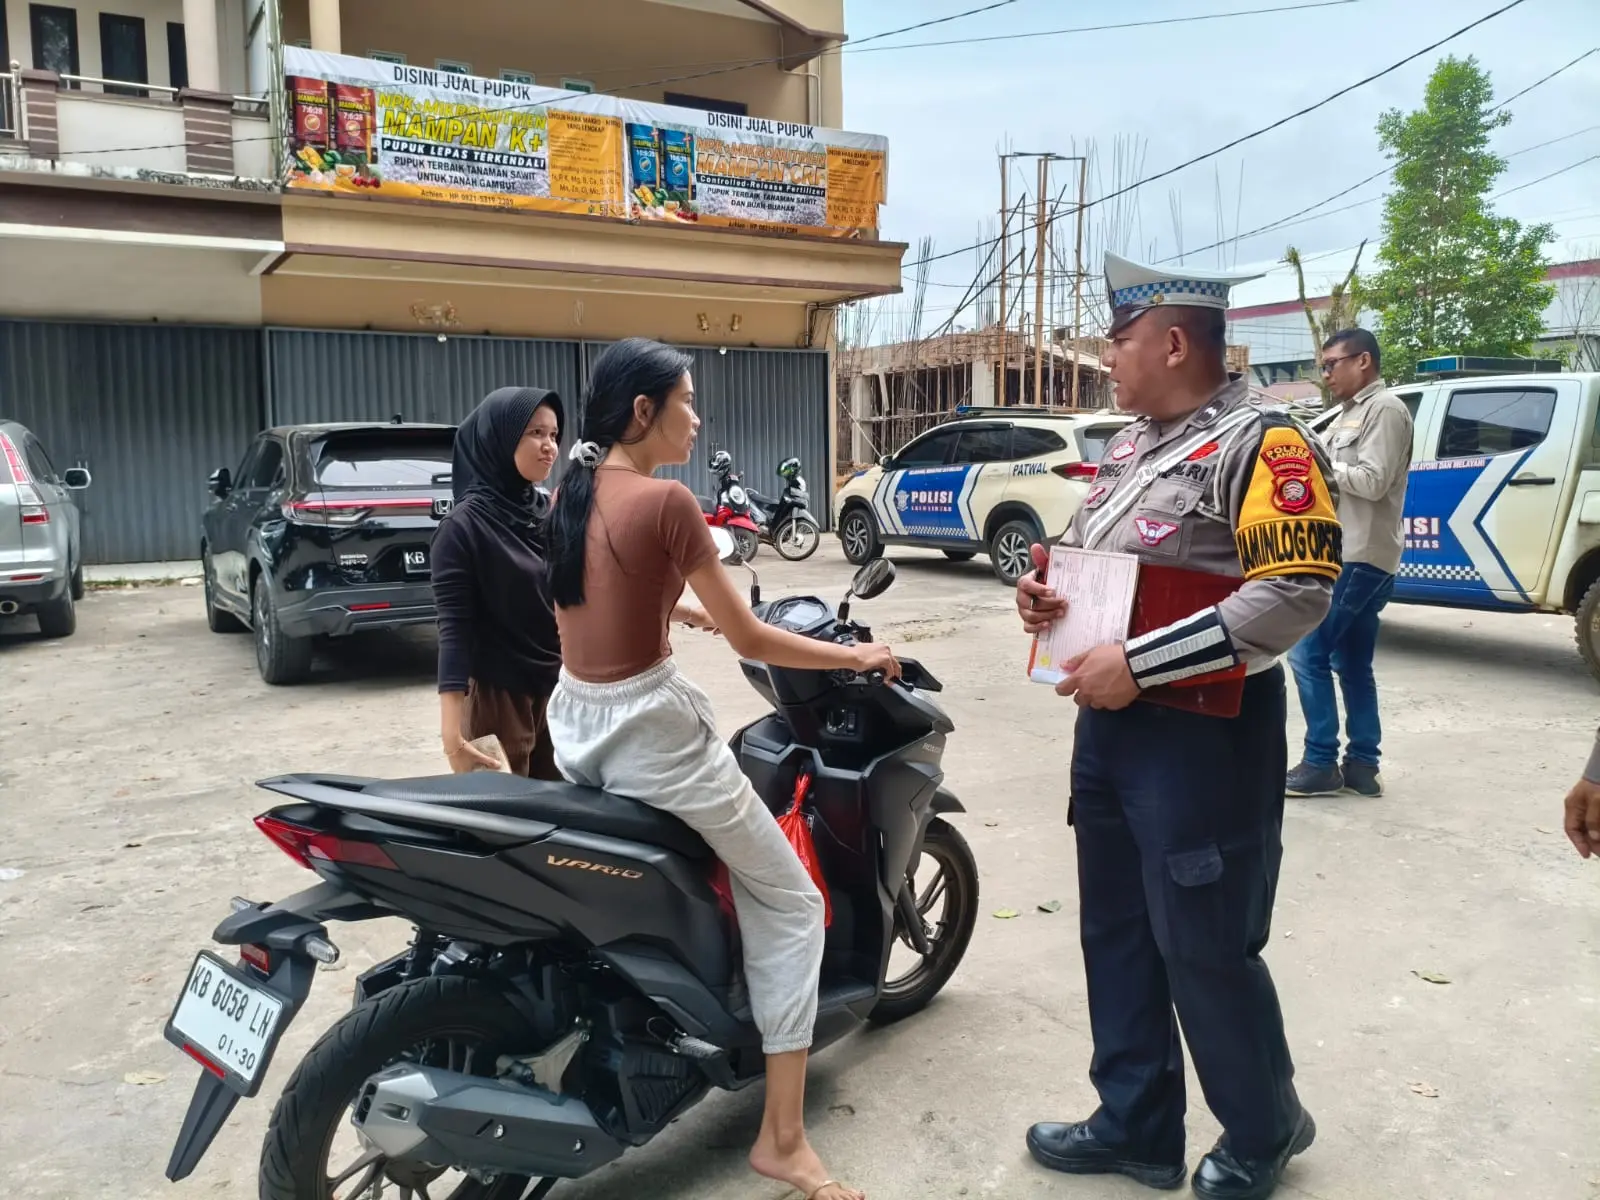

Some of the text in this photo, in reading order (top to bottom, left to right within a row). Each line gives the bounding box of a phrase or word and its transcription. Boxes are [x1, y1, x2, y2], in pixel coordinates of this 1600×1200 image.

[394, 66, 531, 100] DISINI JUAL PUPUK
[383, 109, 498, 149] MAMPAN
[509, 127, 543, 153] K+
[708, 112, 814, 139] DISINI JUAL PUPUK
[383, 140, 545, 168] PUPUK LEPAS TERKENDALI
[394, 156, 536, 181] PUPUK TERBAIK TANAMAN SAWIT
[417, 172, 515, 190] UNTUK TANAH GAMBUT
[700, 175, 825, 196] Controlled-Release Fertilizer
[707, 187, 729, 196] PUPUK
[732, 190, 761, 199] TERBAIK
[763, 193, 795, 203] TANAMAN
[1012, 462, 1048, 477] PATWAL
[911, 491, 953, 504] POLISI
[1404, 517, 1440, 535] ISI
[1405, 539, 1439, 549] NTAS
[405, 551, 425, 565] KB
[547, 854, 644, 879] VARIO
[190, 965, 213, 999] KB
[212, 978, 249, 1022] 6058
